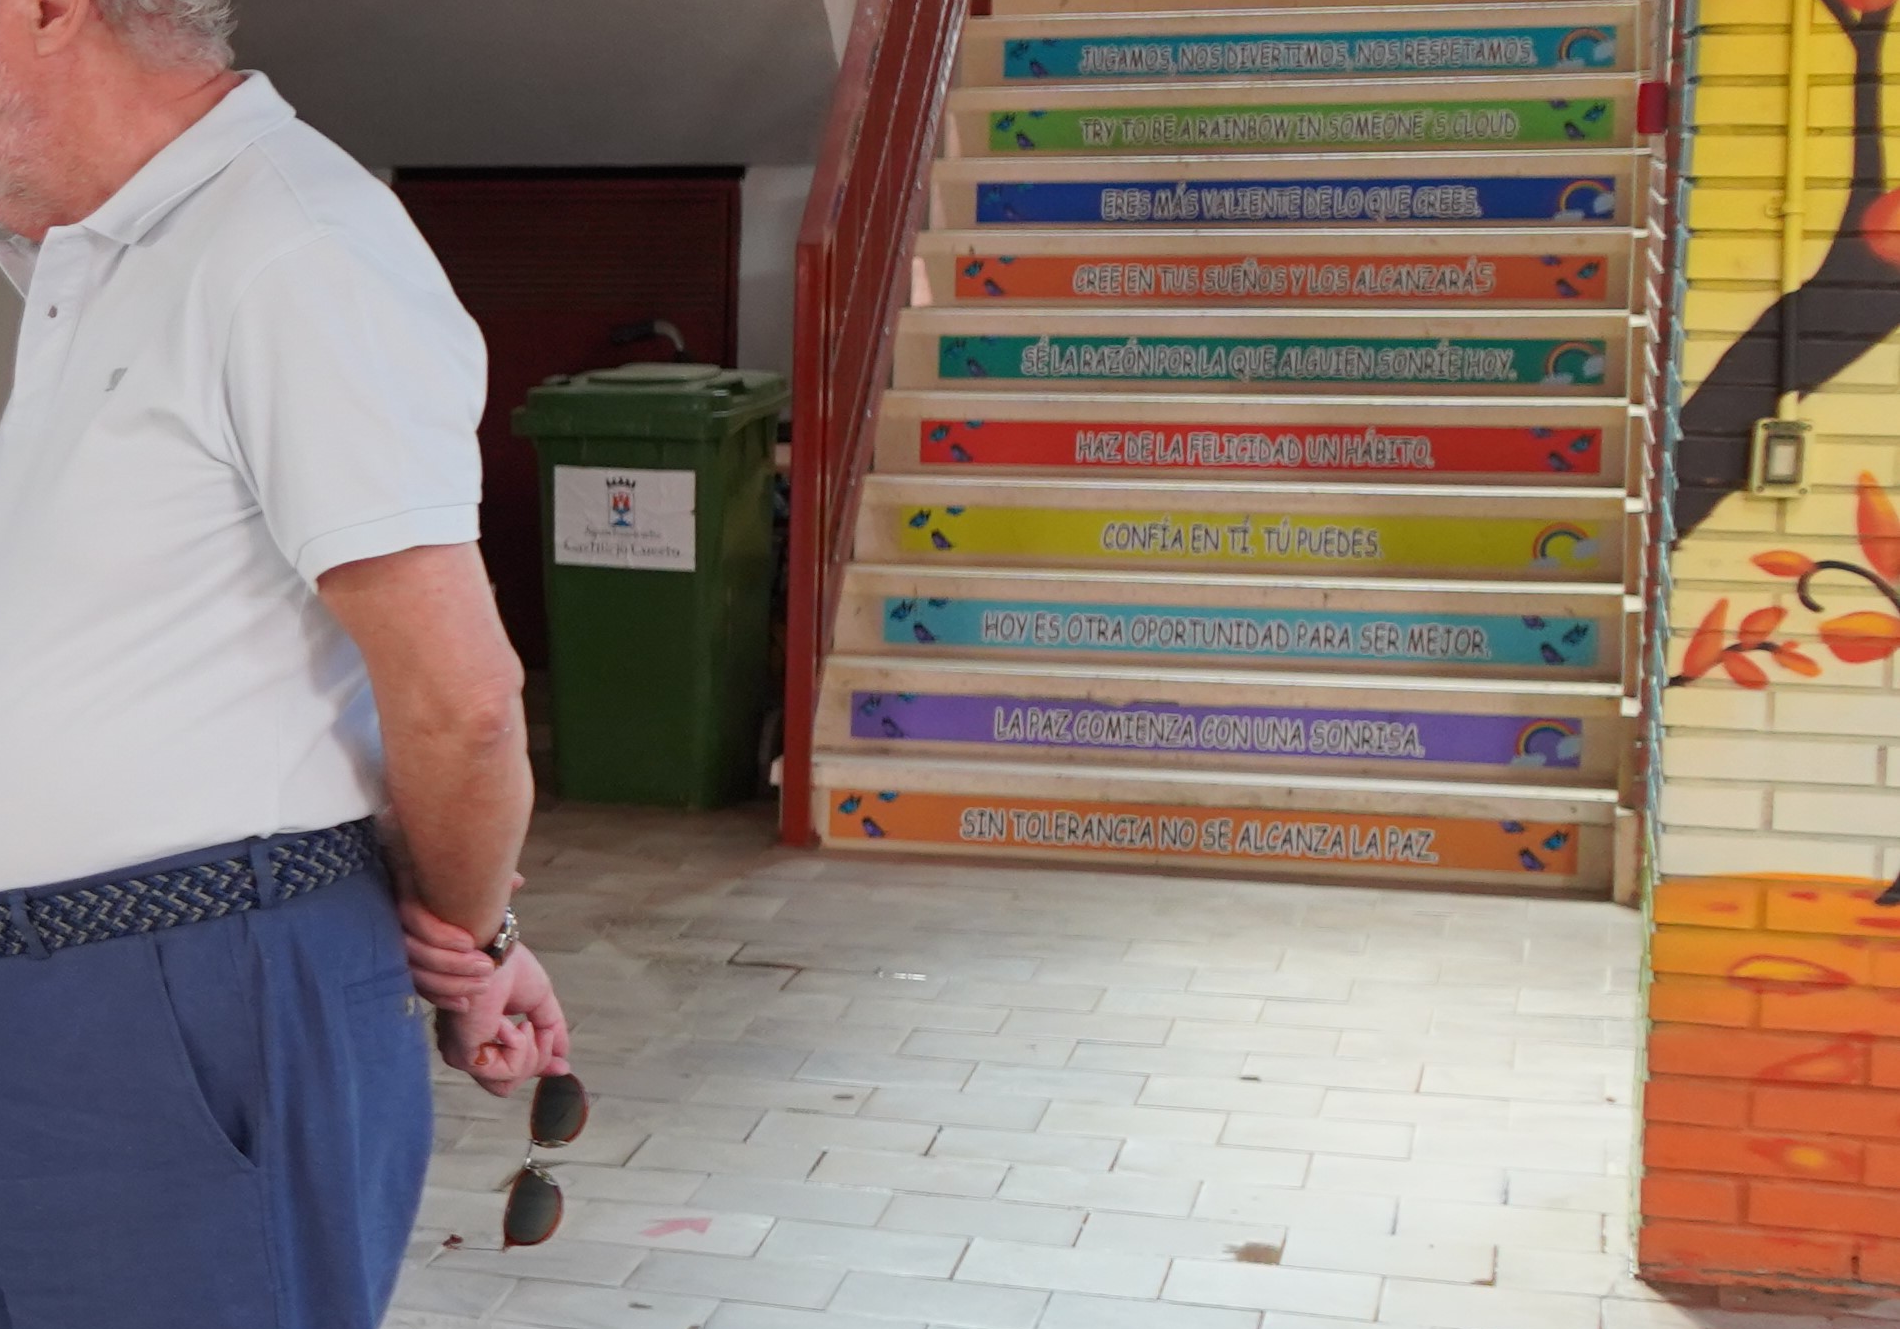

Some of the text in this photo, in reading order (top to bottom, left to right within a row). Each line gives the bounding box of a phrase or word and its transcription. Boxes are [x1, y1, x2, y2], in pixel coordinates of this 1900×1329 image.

[1180, 44, 1221, 69] NOS
[1357, 40, 1399, 67] NOS
[1404, 37, 1536, 66] RESPETAMOS.
[1082, 118, 1115, 144] TRY
[1122, 116, 1148, 143] TO
[1152, 115, 1176, 143] BE
[1179, 116, 1192, 142] A
[1198, 114, 1291, 141] RAINBOW
[1298, 113, 1321, 140] IN
[1454, 110, 1517, 139] CLOUD
[1103, 182, 1482, 221] ERES MÁS VALIENTE DE LO QUE CREES.
[1074, 256, 1495, 295] CREE EN TUS SUEÑOS Y LOS ALCANZARÁS
[1022, 335, 1517, 382] SÉ LA RAZÓN POR LA QUE ALGUIEN SONRÍE HOY.
[1076, 426, 1434, 468] HAZ DE LA FELICIDAD UN HÁBITO.
[1103, 516, 1184, 551] CONFÍA
[1191, 523, 1220, 553] EN
[1262, 517, 1291, 555] TÚ
[1297, 525, 1383, 558] PUEDES.
[984, 611, 1027, 642] HOY
[1033, 611, 1060, 643] ES
[1067, 613, 1123, 645] OTRA
[1131, 615, 1290, 652] OPORTUNIDAD
[1296, 621, 1351, 652] PARA
[1360, 623, 1400, 655] SER
[995, 707, 1425, 758] LA PAZ COMIENZA CON UNA SONRISA.
[961, 807, 1005, 840] SIN
[1011, 810, 1154, 846] TOLERANCIA
[1159, 815, 1197, 849] NO
[1201, 818, 1233, 854] SE
[1237, 821, 1344, 860] ALCANZA
[1350, 824, 1381, 859] LA
